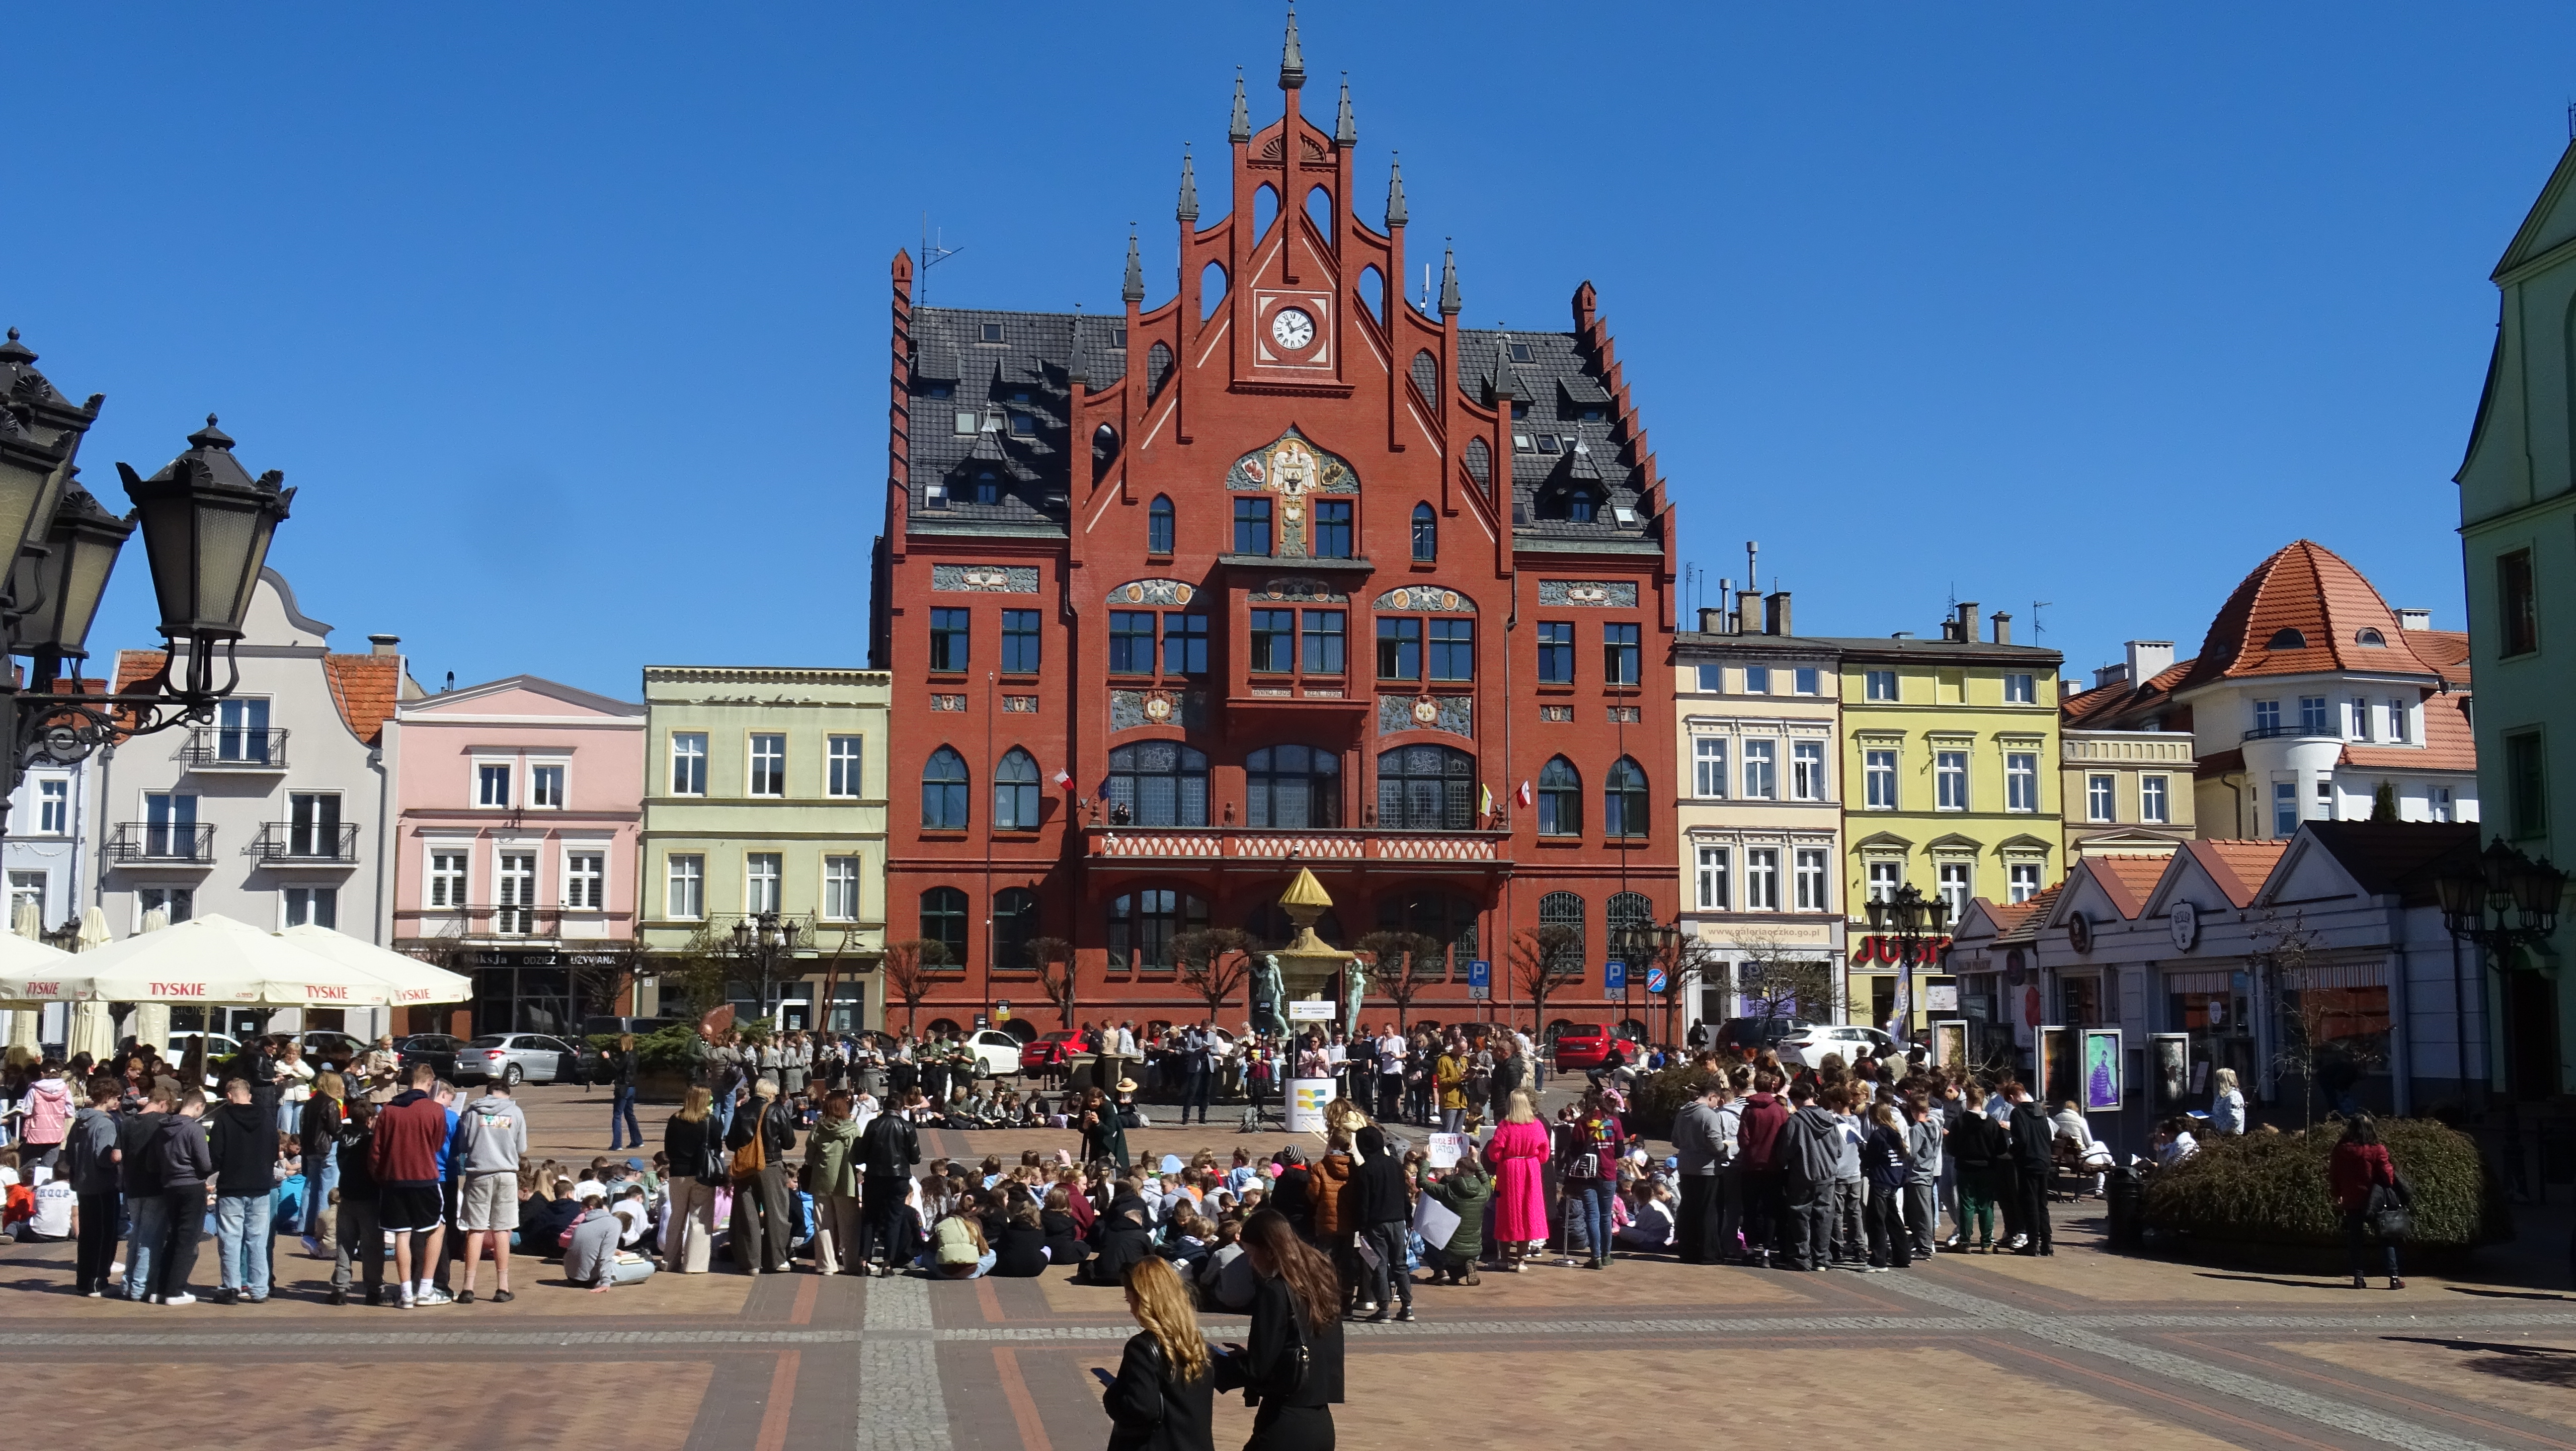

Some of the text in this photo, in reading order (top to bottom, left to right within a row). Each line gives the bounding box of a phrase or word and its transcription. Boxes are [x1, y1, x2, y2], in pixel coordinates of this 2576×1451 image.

[1708, 928, 1820, 937] www.galeriaoczko.go.pl
[1473, 963, 1485, 979] P
[1609, 965, 1621, 980] P
[27, 982, 60, 995] TYSKIE
[149, 982, 206, 996] TYSKIE
[305, 985, 348, 999] TYSKIE
